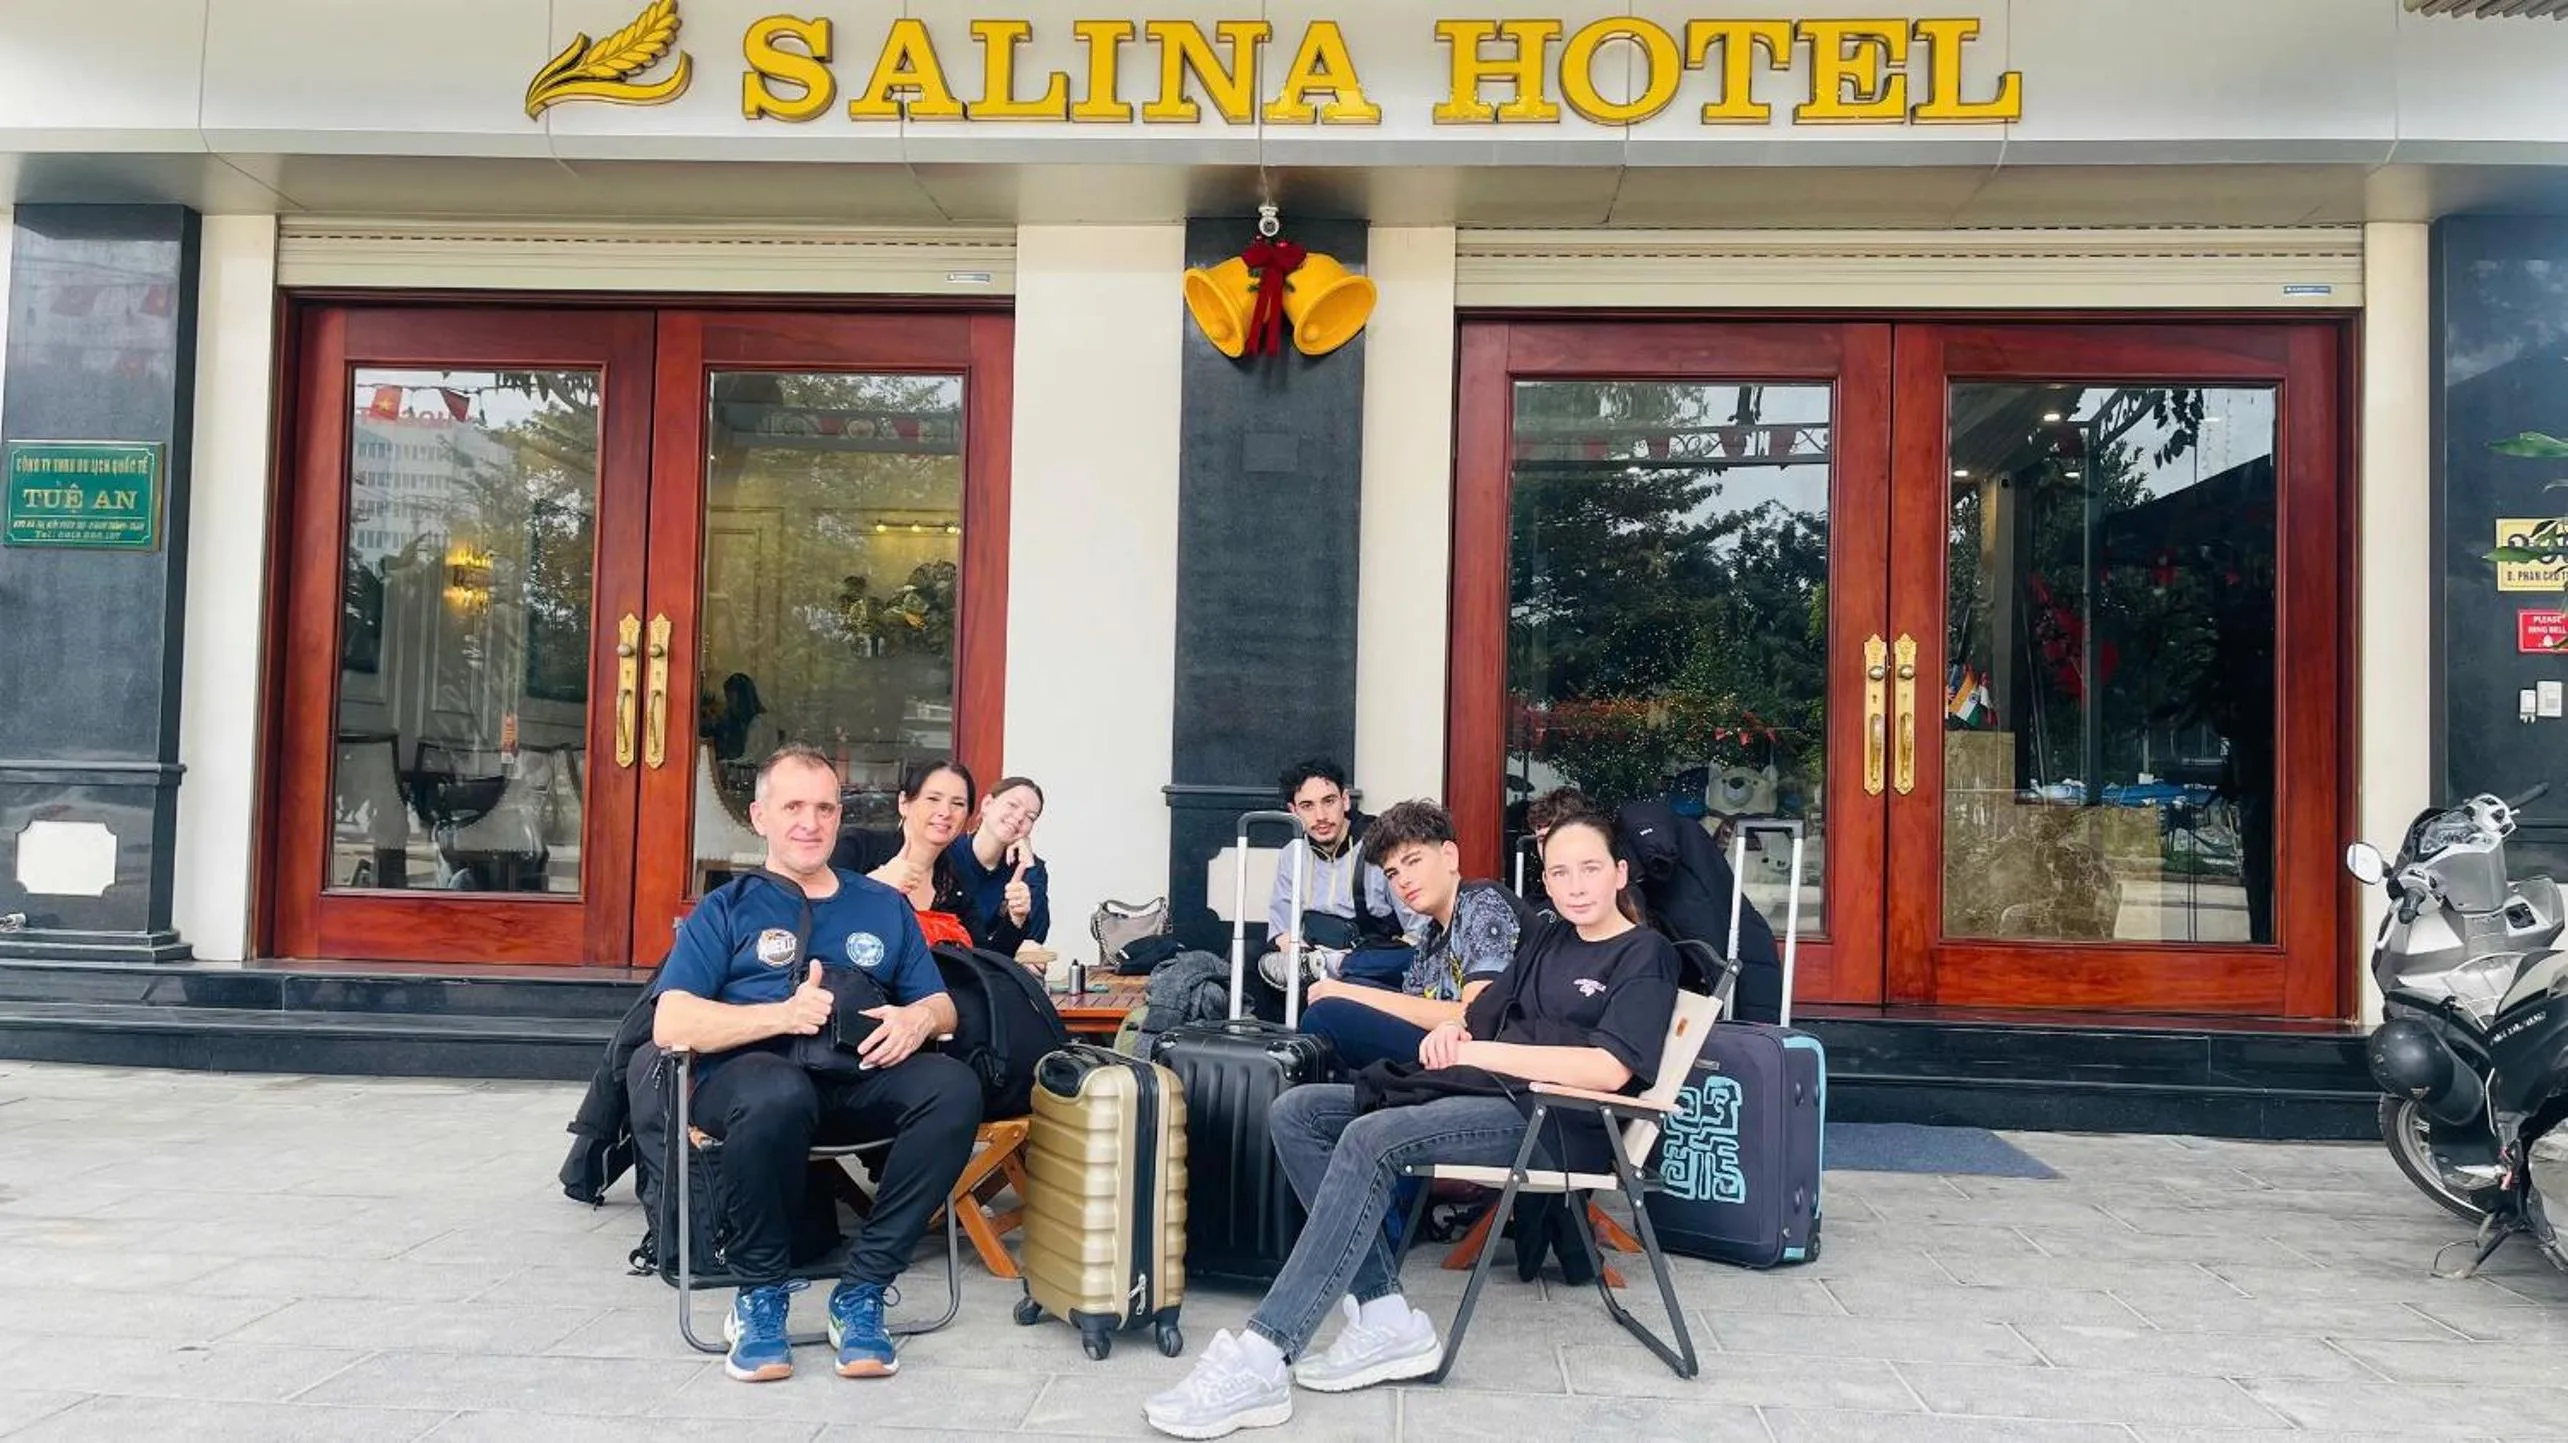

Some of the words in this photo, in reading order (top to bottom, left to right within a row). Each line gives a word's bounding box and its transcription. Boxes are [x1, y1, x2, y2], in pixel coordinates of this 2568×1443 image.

[742, 14, 1382, 124] SALINA
[1433, 16, 2022, 126] HOTEL
[92, 490, 138, 510] AN
[2533, 615, 2561, 624] PLEASE
